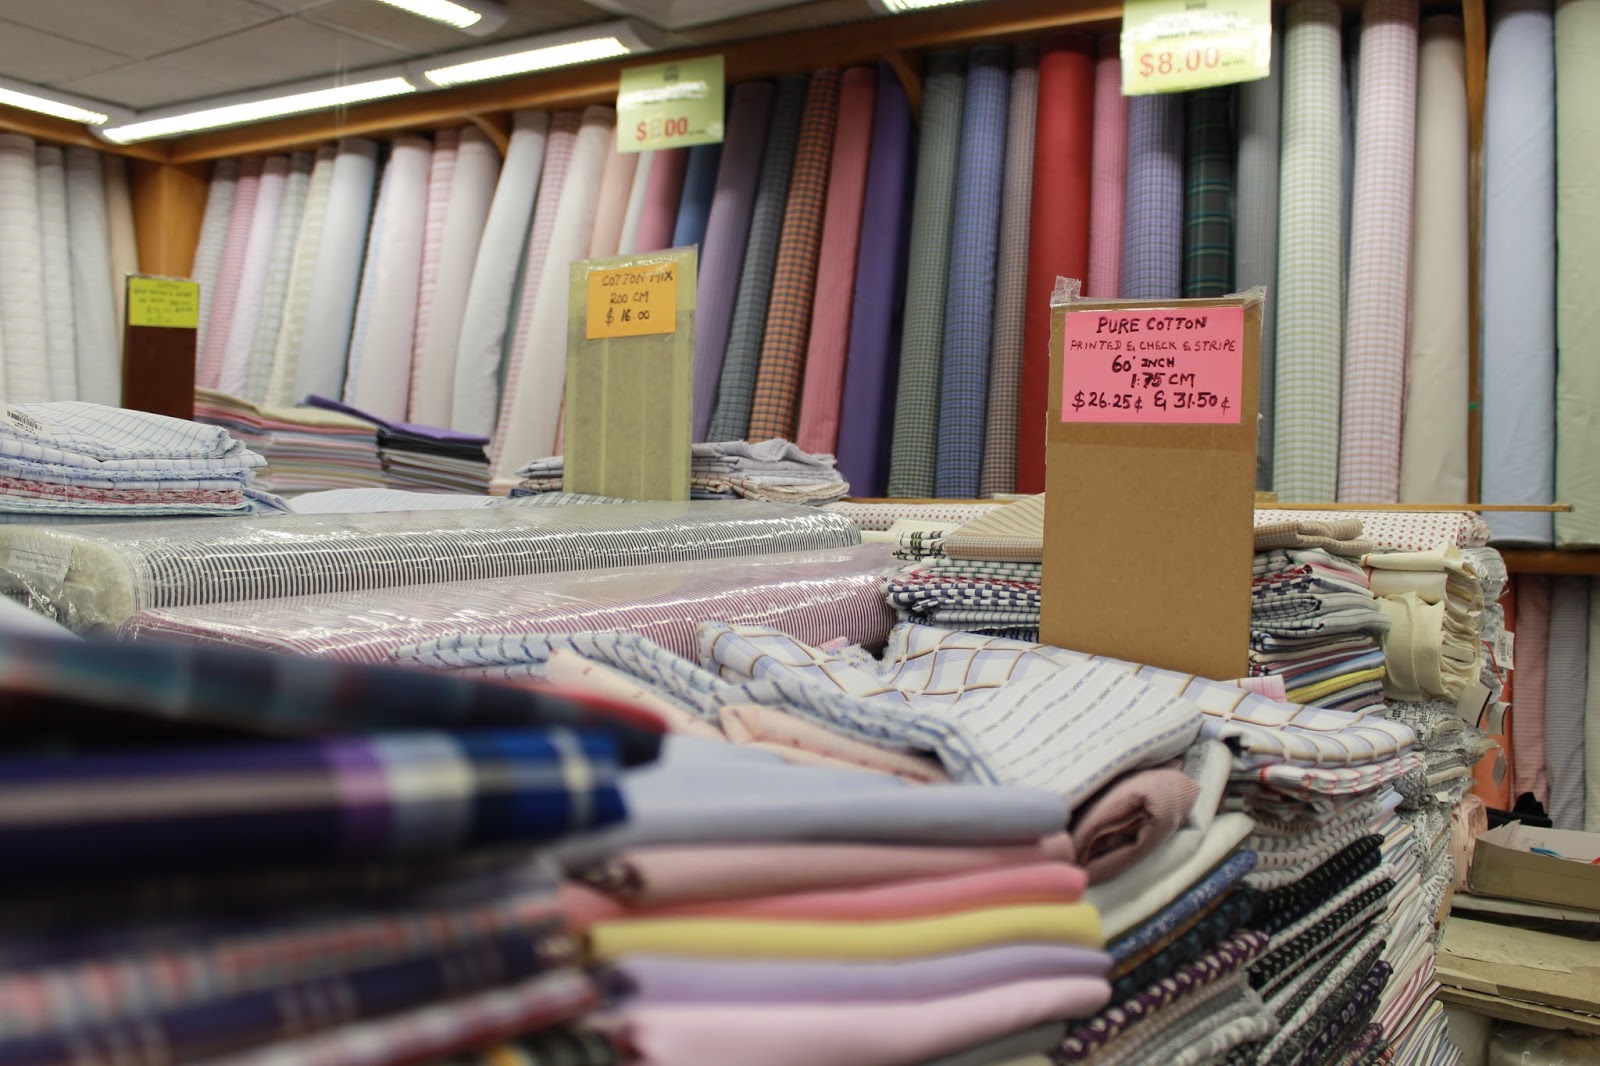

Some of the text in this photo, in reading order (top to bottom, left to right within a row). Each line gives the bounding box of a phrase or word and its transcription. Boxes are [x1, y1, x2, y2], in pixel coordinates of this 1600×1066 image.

[1139, 48, 1220, 78] $8.00
[610, 291, 649, 304] 200 CM
[1096, 316, 1140, 334] PURE
[1070, 340, 1121, 351] PRINTED
[1139, 340, 1177, 350] CHECK
[1194, 339, 1236, 351] STRIPE
[1141, 357, 1175, 368] INCH
[1168, 373, 1196, 387] CM
